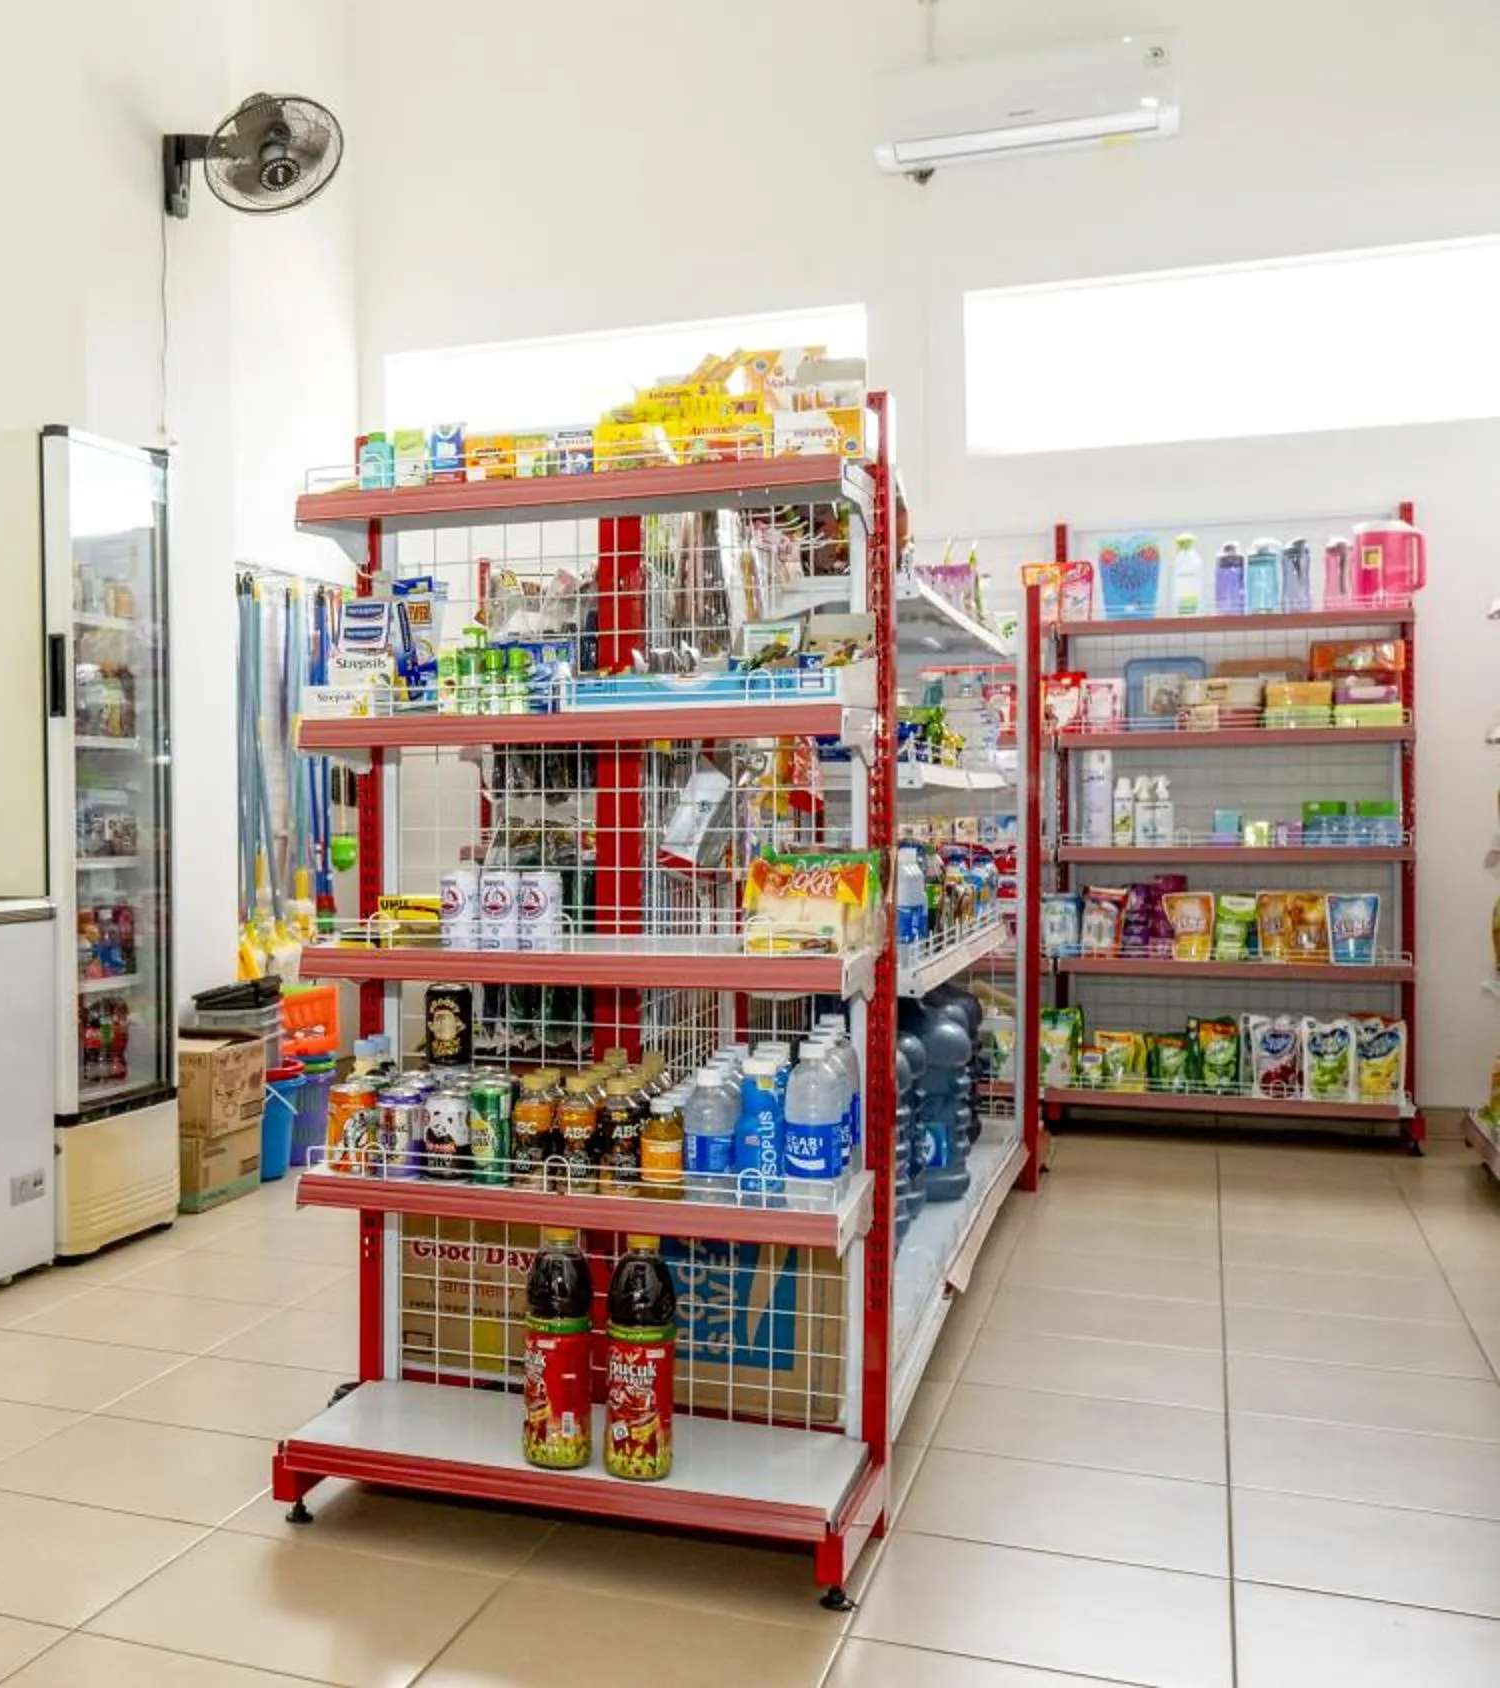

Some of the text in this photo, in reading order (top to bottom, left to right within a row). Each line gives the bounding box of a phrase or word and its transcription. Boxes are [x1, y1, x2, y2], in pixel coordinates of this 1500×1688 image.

[515, 1121, 539, 1135] BC
[563, 1125, 593, 1139] ABC
[758, 1110, 777, 1178] SOPLUS
[706, 1250, 740, 1356] SWE
